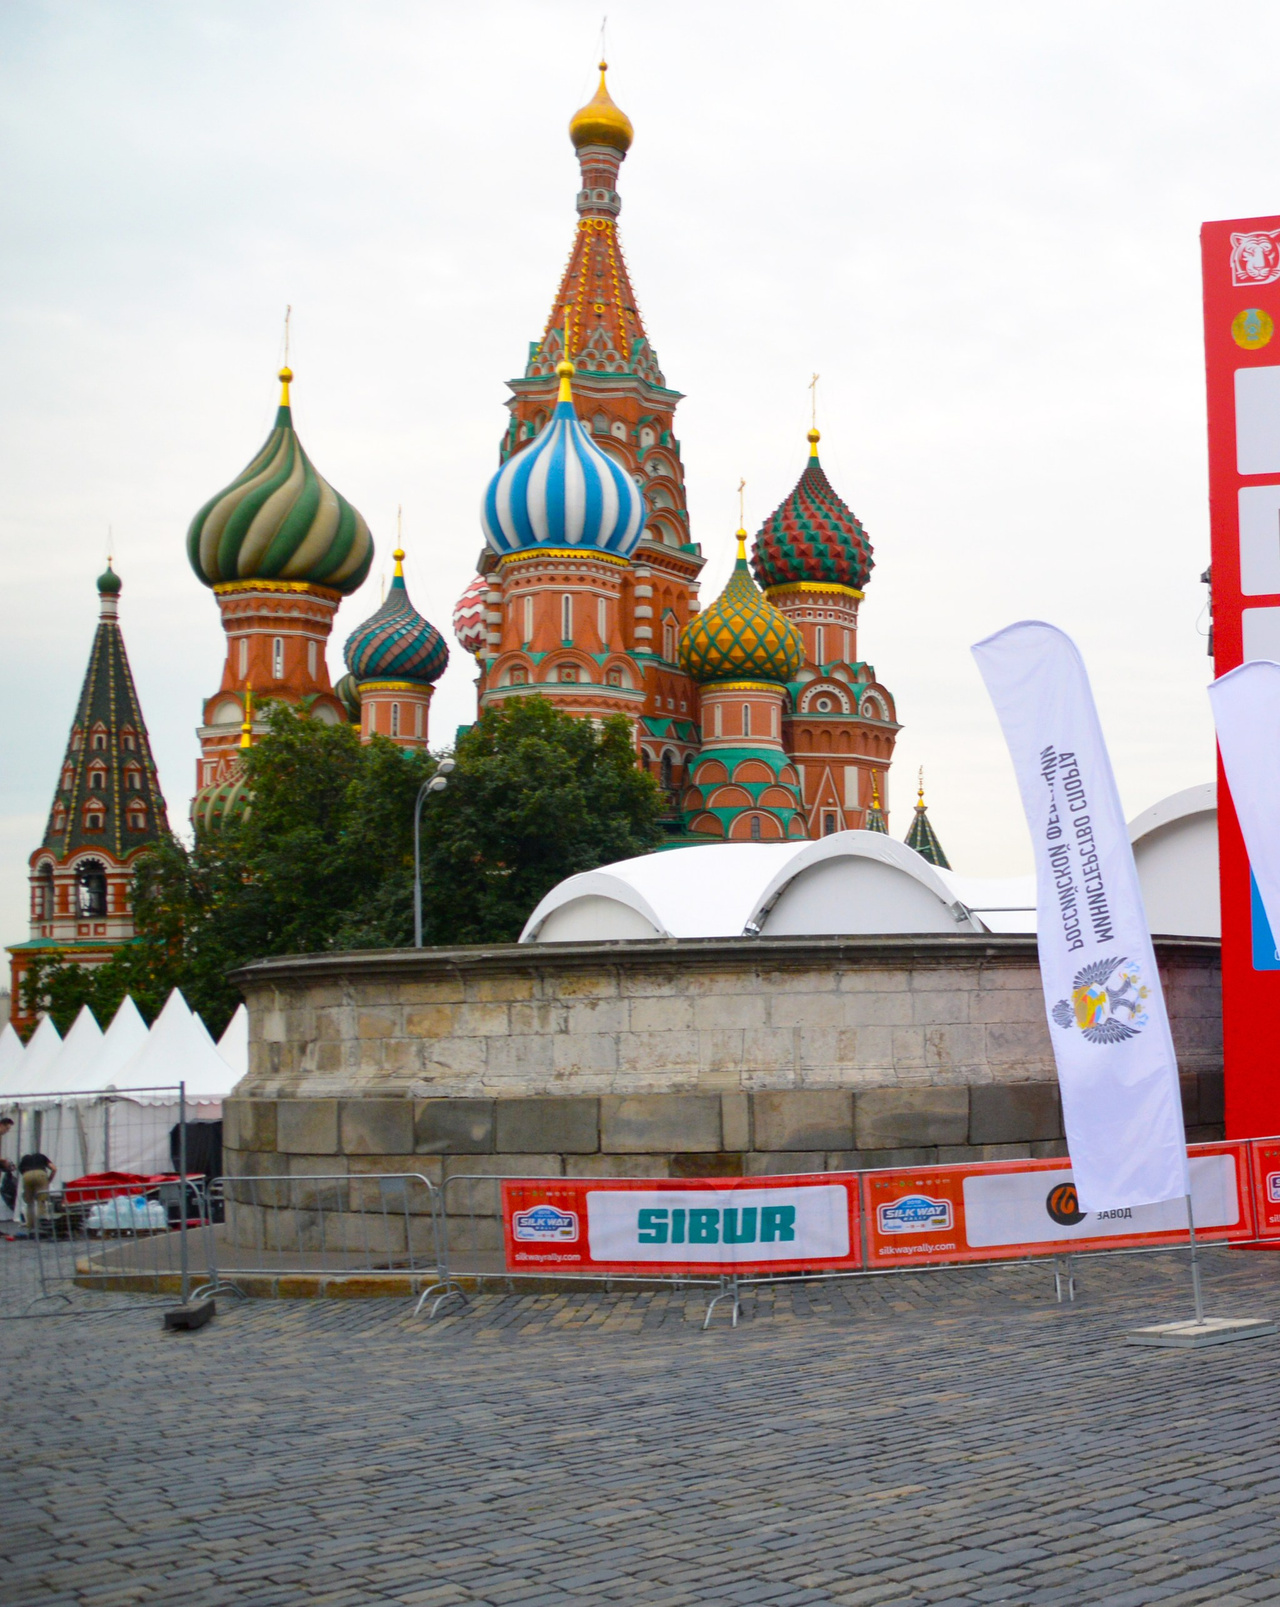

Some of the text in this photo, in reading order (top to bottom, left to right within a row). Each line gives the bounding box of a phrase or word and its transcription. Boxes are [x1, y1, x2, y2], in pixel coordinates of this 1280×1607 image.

[885, 1206, 945, 1218] SILK WAY
[1096, 1207, 1132, 1220] ЗАВОД
[519, 1218, 571, 1226] SILK WAY
[638, 1205, 796, 1245] SIBUR
[878, 1243, 956, 1256] silkwayrally.com
[515, 1252, 581, 1262] silkwayrally.com
